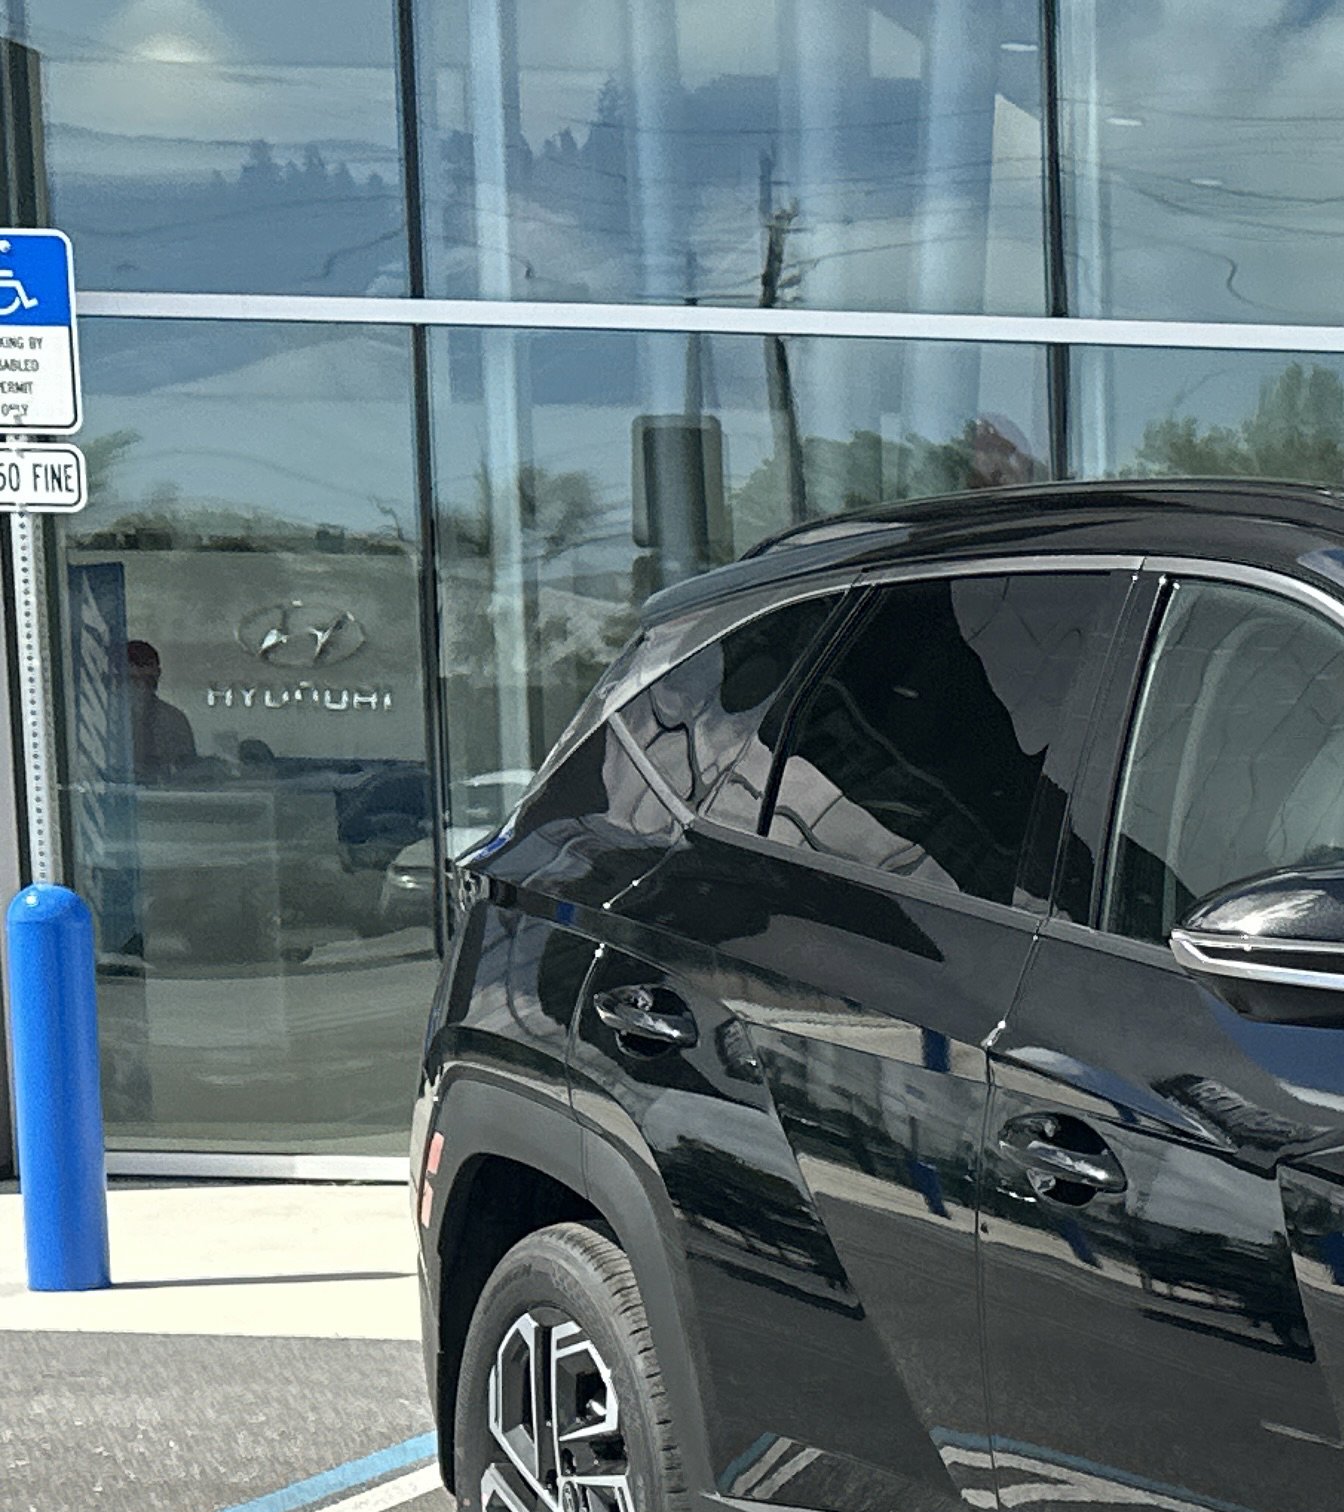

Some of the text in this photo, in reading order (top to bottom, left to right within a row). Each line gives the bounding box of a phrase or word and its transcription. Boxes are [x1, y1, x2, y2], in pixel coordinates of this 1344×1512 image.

[28, 336, 44, 350] BY
[0, 381, 33, 394] ERMIT
[32, 462, 75, 493] FINE
